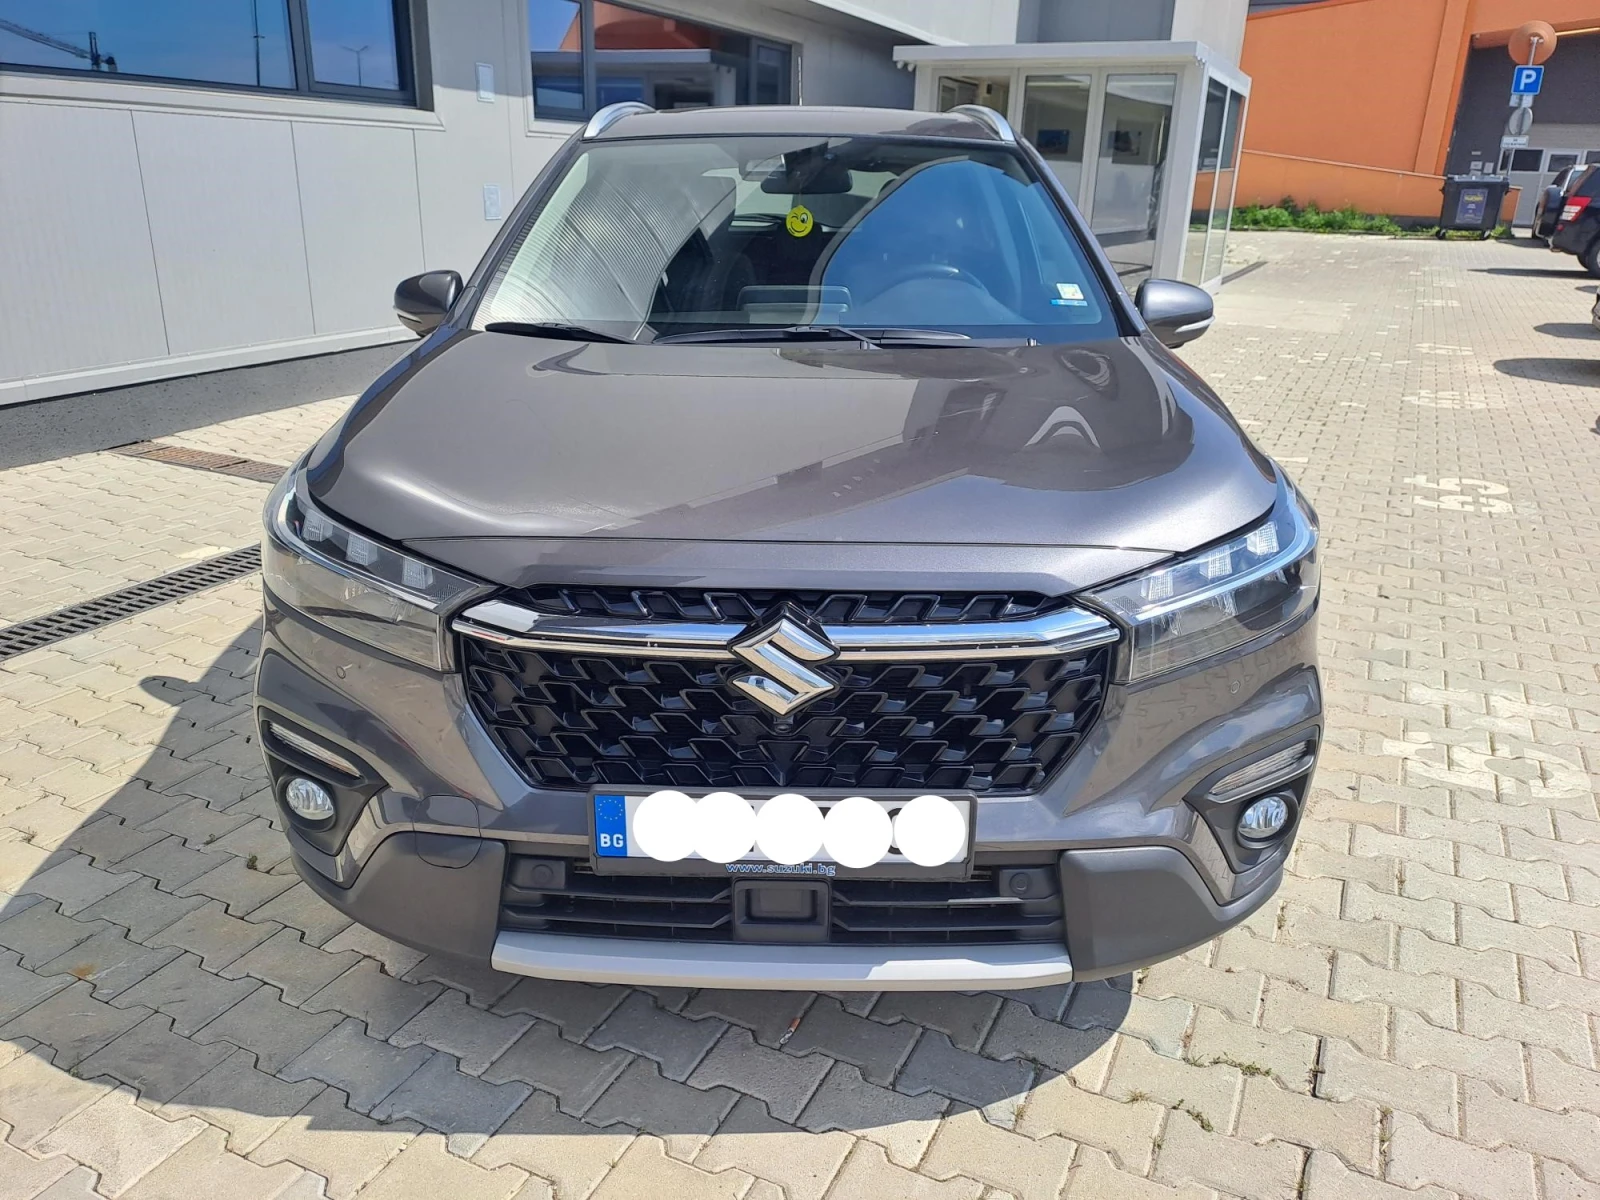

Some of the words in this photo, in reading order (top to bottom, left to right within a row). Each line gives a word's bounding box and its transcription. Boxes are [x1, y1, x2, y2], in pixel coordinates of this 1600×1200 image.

[1520, 70, 1537, 91] P
[600, 833, 624, 848] BG
[725, 862, 837, 877] www.suzuki.bg
